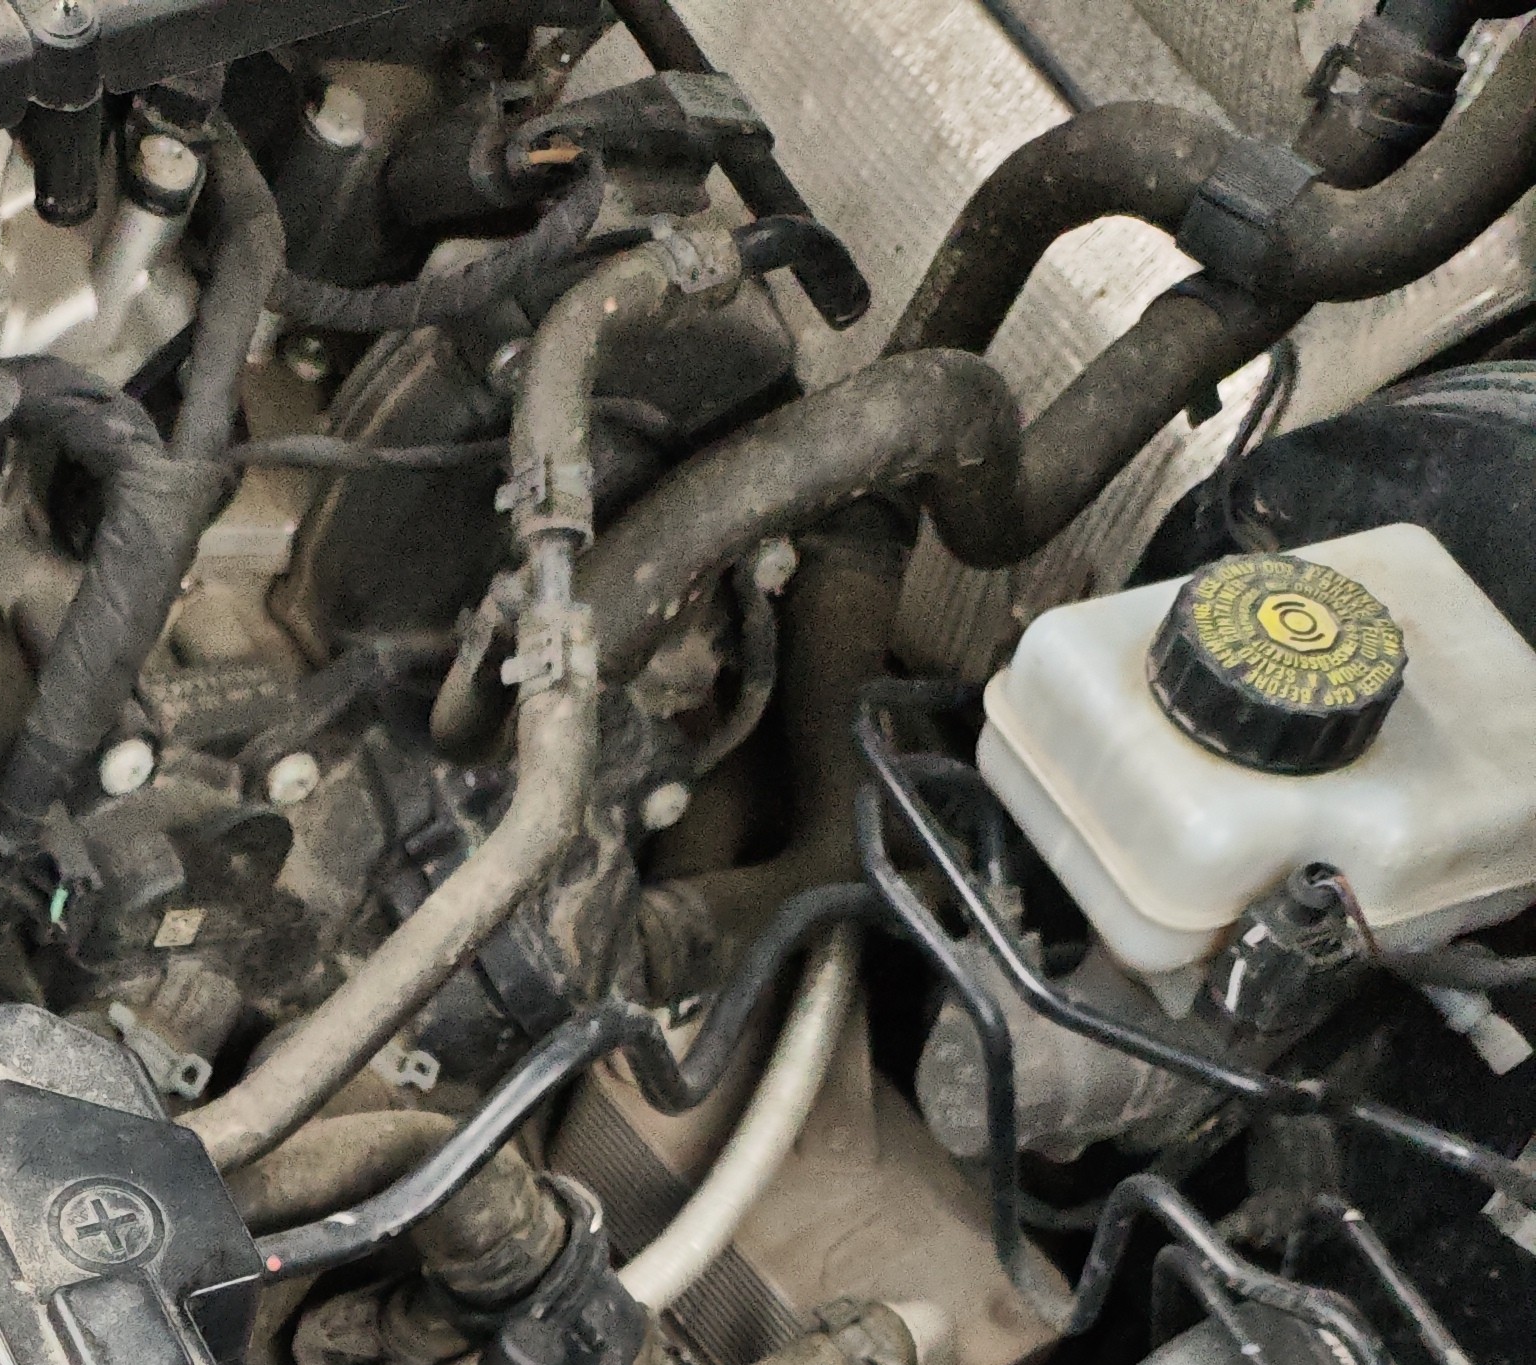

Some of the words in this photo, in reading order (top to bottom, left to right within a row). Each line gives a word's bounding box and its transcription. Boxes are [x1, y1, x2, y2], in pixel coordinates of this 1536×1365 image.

[1244, 668, 1313, 704] BEFORE
[1326, 661, 1369, 686] FROM
[1356, 660, 1395, 696] FILLER
[1324, 686, 1355, 705] CAP
